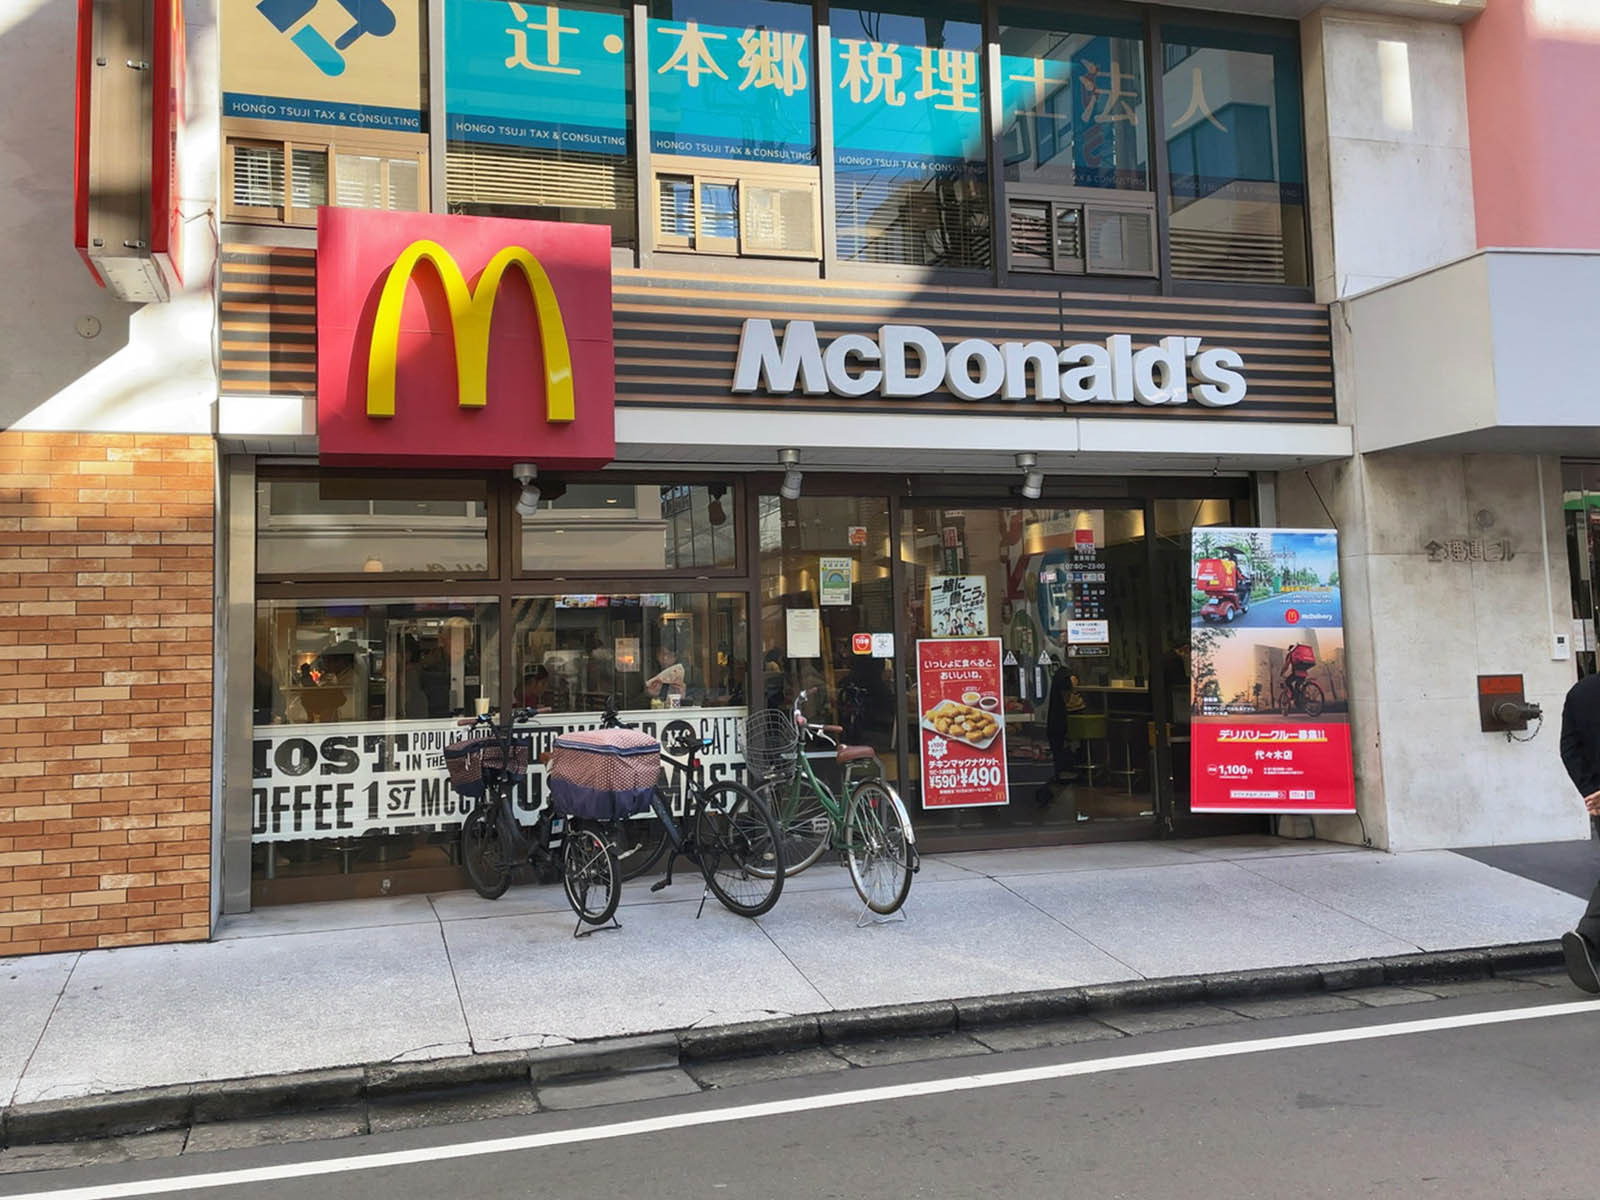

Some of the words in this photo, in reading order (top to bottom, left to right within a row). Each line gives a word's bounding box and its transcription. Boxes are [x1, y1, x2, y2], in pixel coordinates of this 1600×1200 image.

[232, 102, 276, 115] HONGO
[279, 105, 311, 118] TSUJI
[314, 109, 335, 120] TAX
[339, 111, 346, 120] &
[350, 112, 419, 128] CONSULTING
[456, 122, 495, 135] HONGO
[498, 125, 527, 138] TSUJI
[530, 129, 549, 140] TAX
[552, 131, 560, 140] &
[562, 132, 625, 146] CONSULTING
[656, 140, 692, 151] HONGO
[695, 142, 722, 154] TSUJI
[724, 145, 742, 155] TAX
[745, 147, 751, 156] &
[753, 148, 812, 161] CONSULTING
[838, 155, 873, 167] HONGO
[874, 158, 899, 169] TSUJI
[901, 160, 919, 170] TAX
[920, 161, 927, 171] &
[731, 319, 1248, 407] McDonald's
[406, 754, 422, 771] IN
[426, 756, 446, 769] THE
[1254, 750, 1293, 760] 代々木店
[928, 775, 957, 789] ¥590
[959, 767, 1001, 787] ¥490
